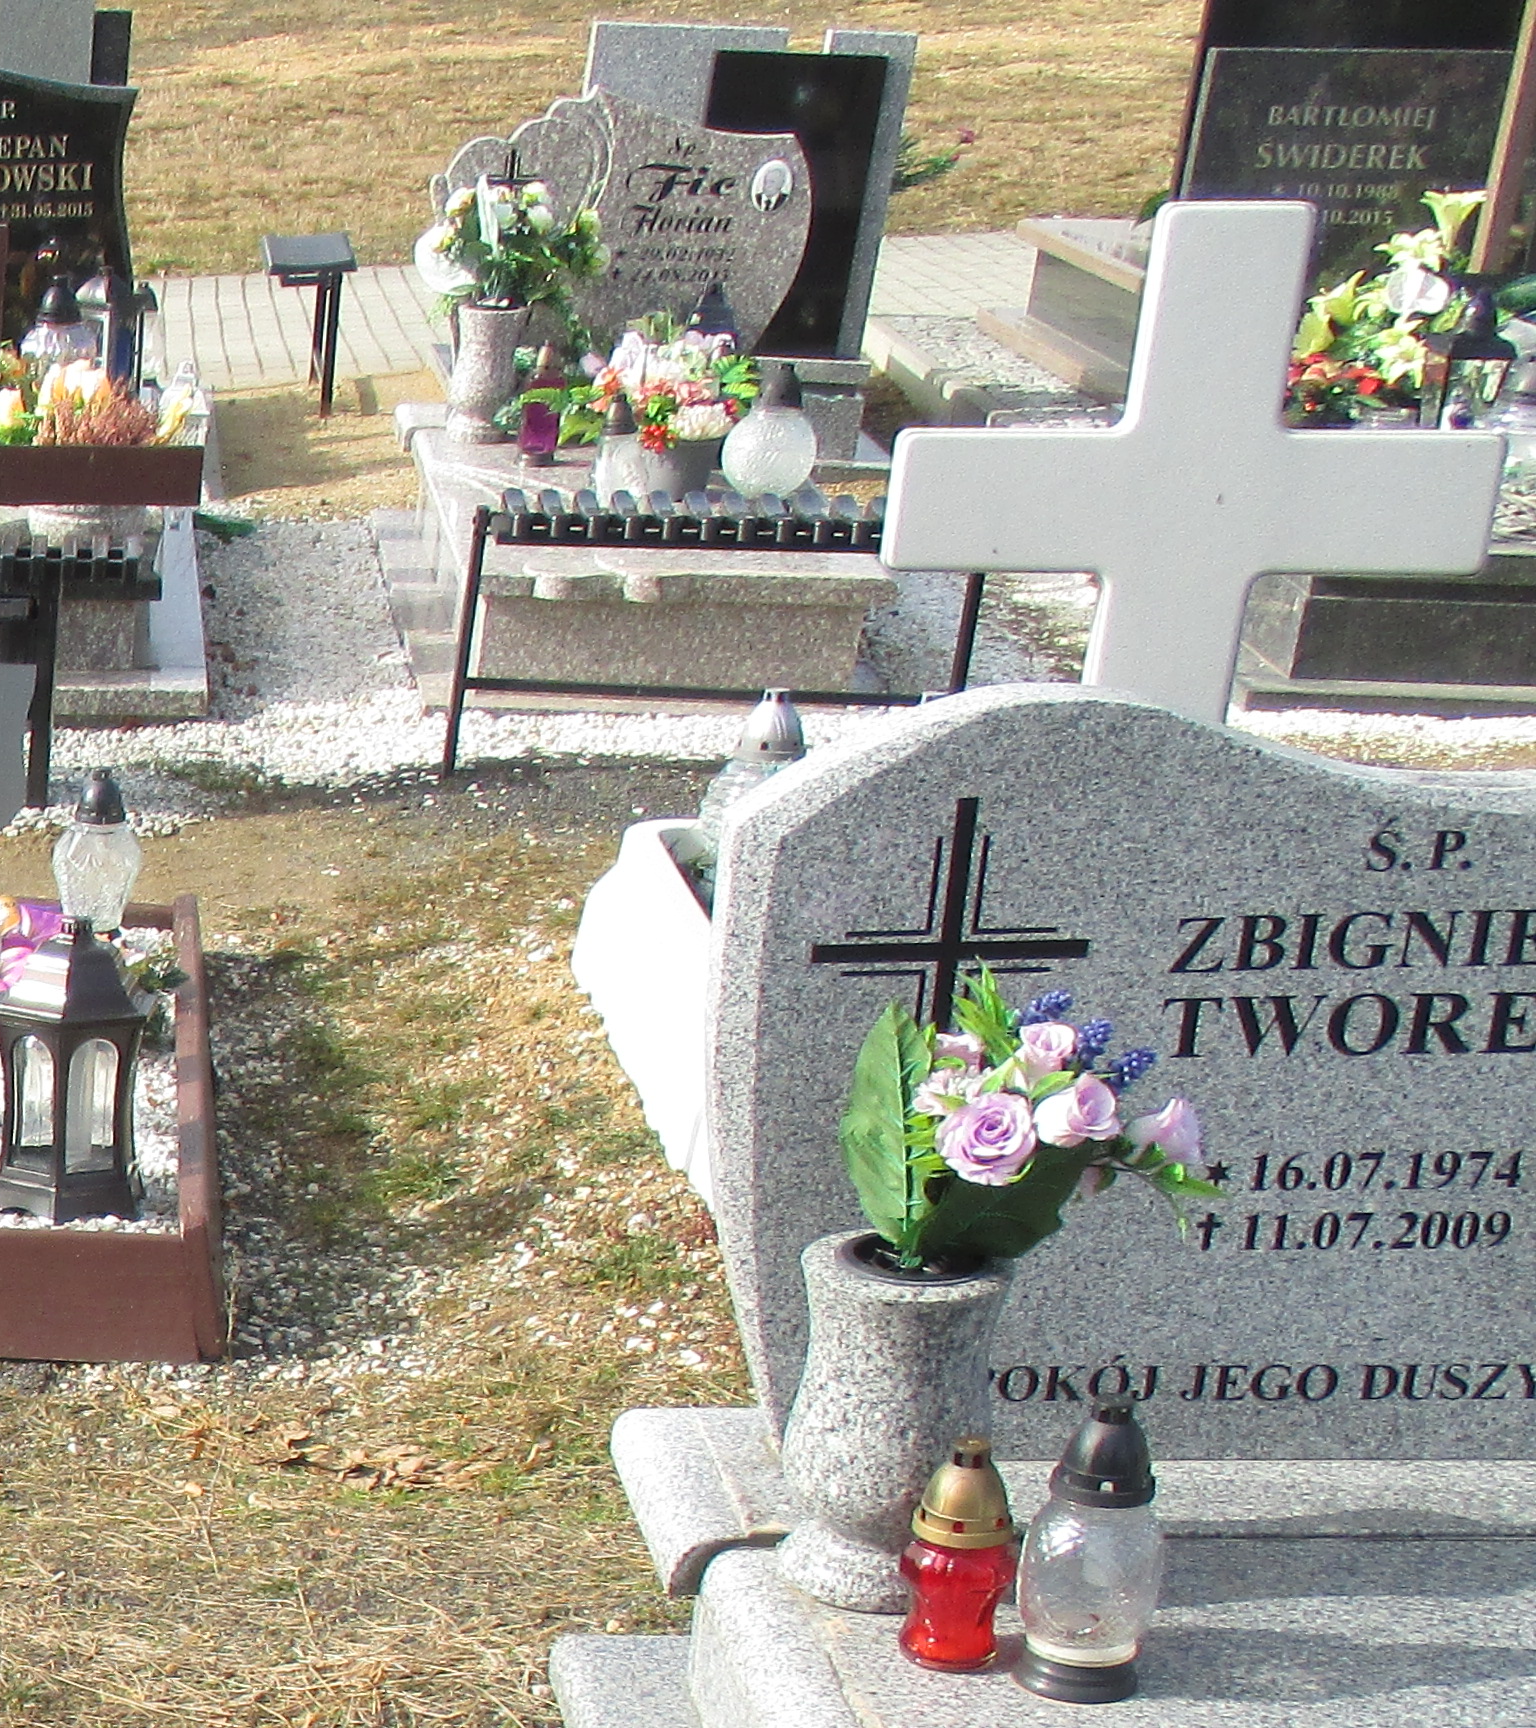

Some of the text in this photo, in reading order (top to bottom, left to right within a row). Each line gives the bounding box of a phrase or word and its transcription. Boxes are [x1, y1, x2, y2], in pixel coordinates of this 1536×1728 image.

[1255, 136, 1430, 169] ŚWIDEREK
[627, 163, 736, 201] Fic
[621, 204, 734, 236] Florian
[1163, 991, 1536, 1058] TWORE
[1250, 1150, 1526, 1191] 16.07.1974
[1241, 1211, 1513, 1250] 11.07.2009
[988, 1354, 1163, 1402] OKÓJ
[1180, 1363, 1339, 1401] JEGO
